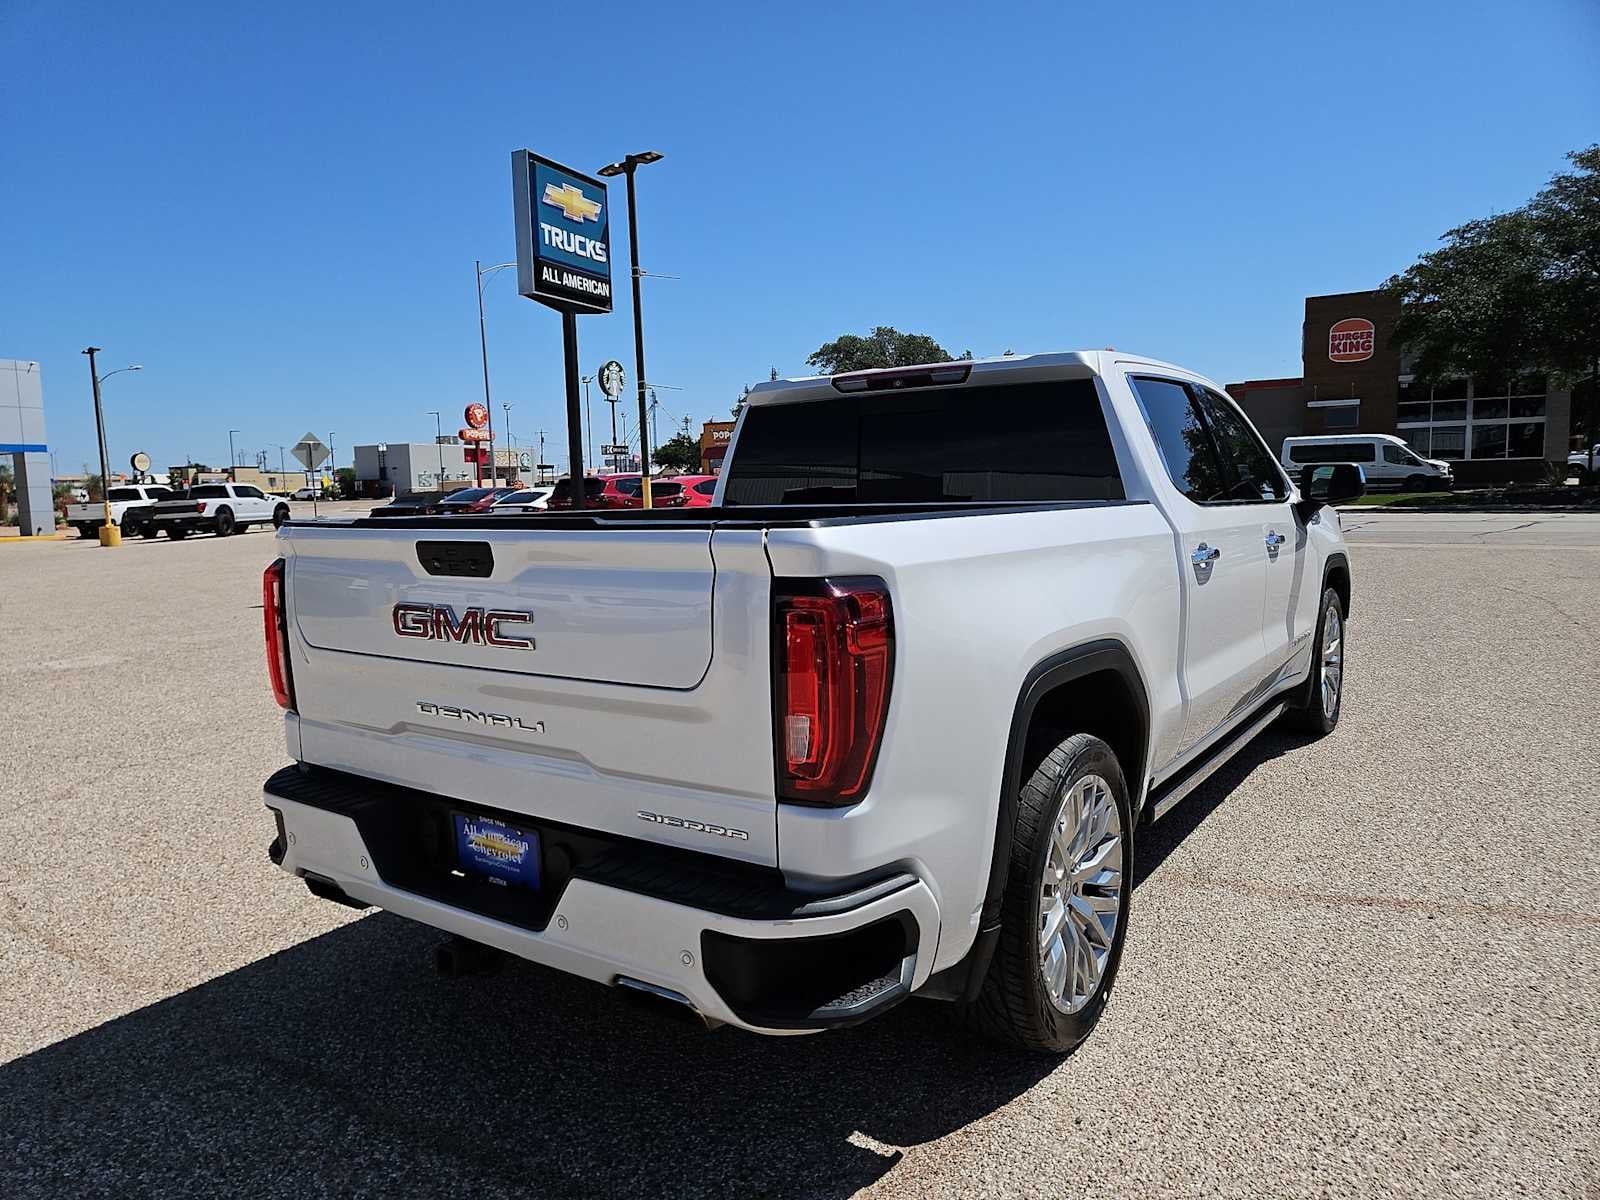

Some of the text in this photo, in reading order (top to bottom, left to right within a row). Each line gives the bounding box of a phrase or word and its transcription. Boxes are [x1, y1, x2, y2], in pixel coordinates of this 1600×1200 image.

[540, 222, 606, 262] TRUCKS
[542, 265, 610, 297] ALL AMERICAN
[1331, 331, 1372, 342] BURGER
[1331, 340, 1372, 353] KING
[392, 601, 536, 651] GMC
[416, 701, 545, 733] DENALI
[463, 823, 529, 851] All American
[637, 810, 749, 841] SIERRA
[471, 841, 522, 864] Chevrolet
